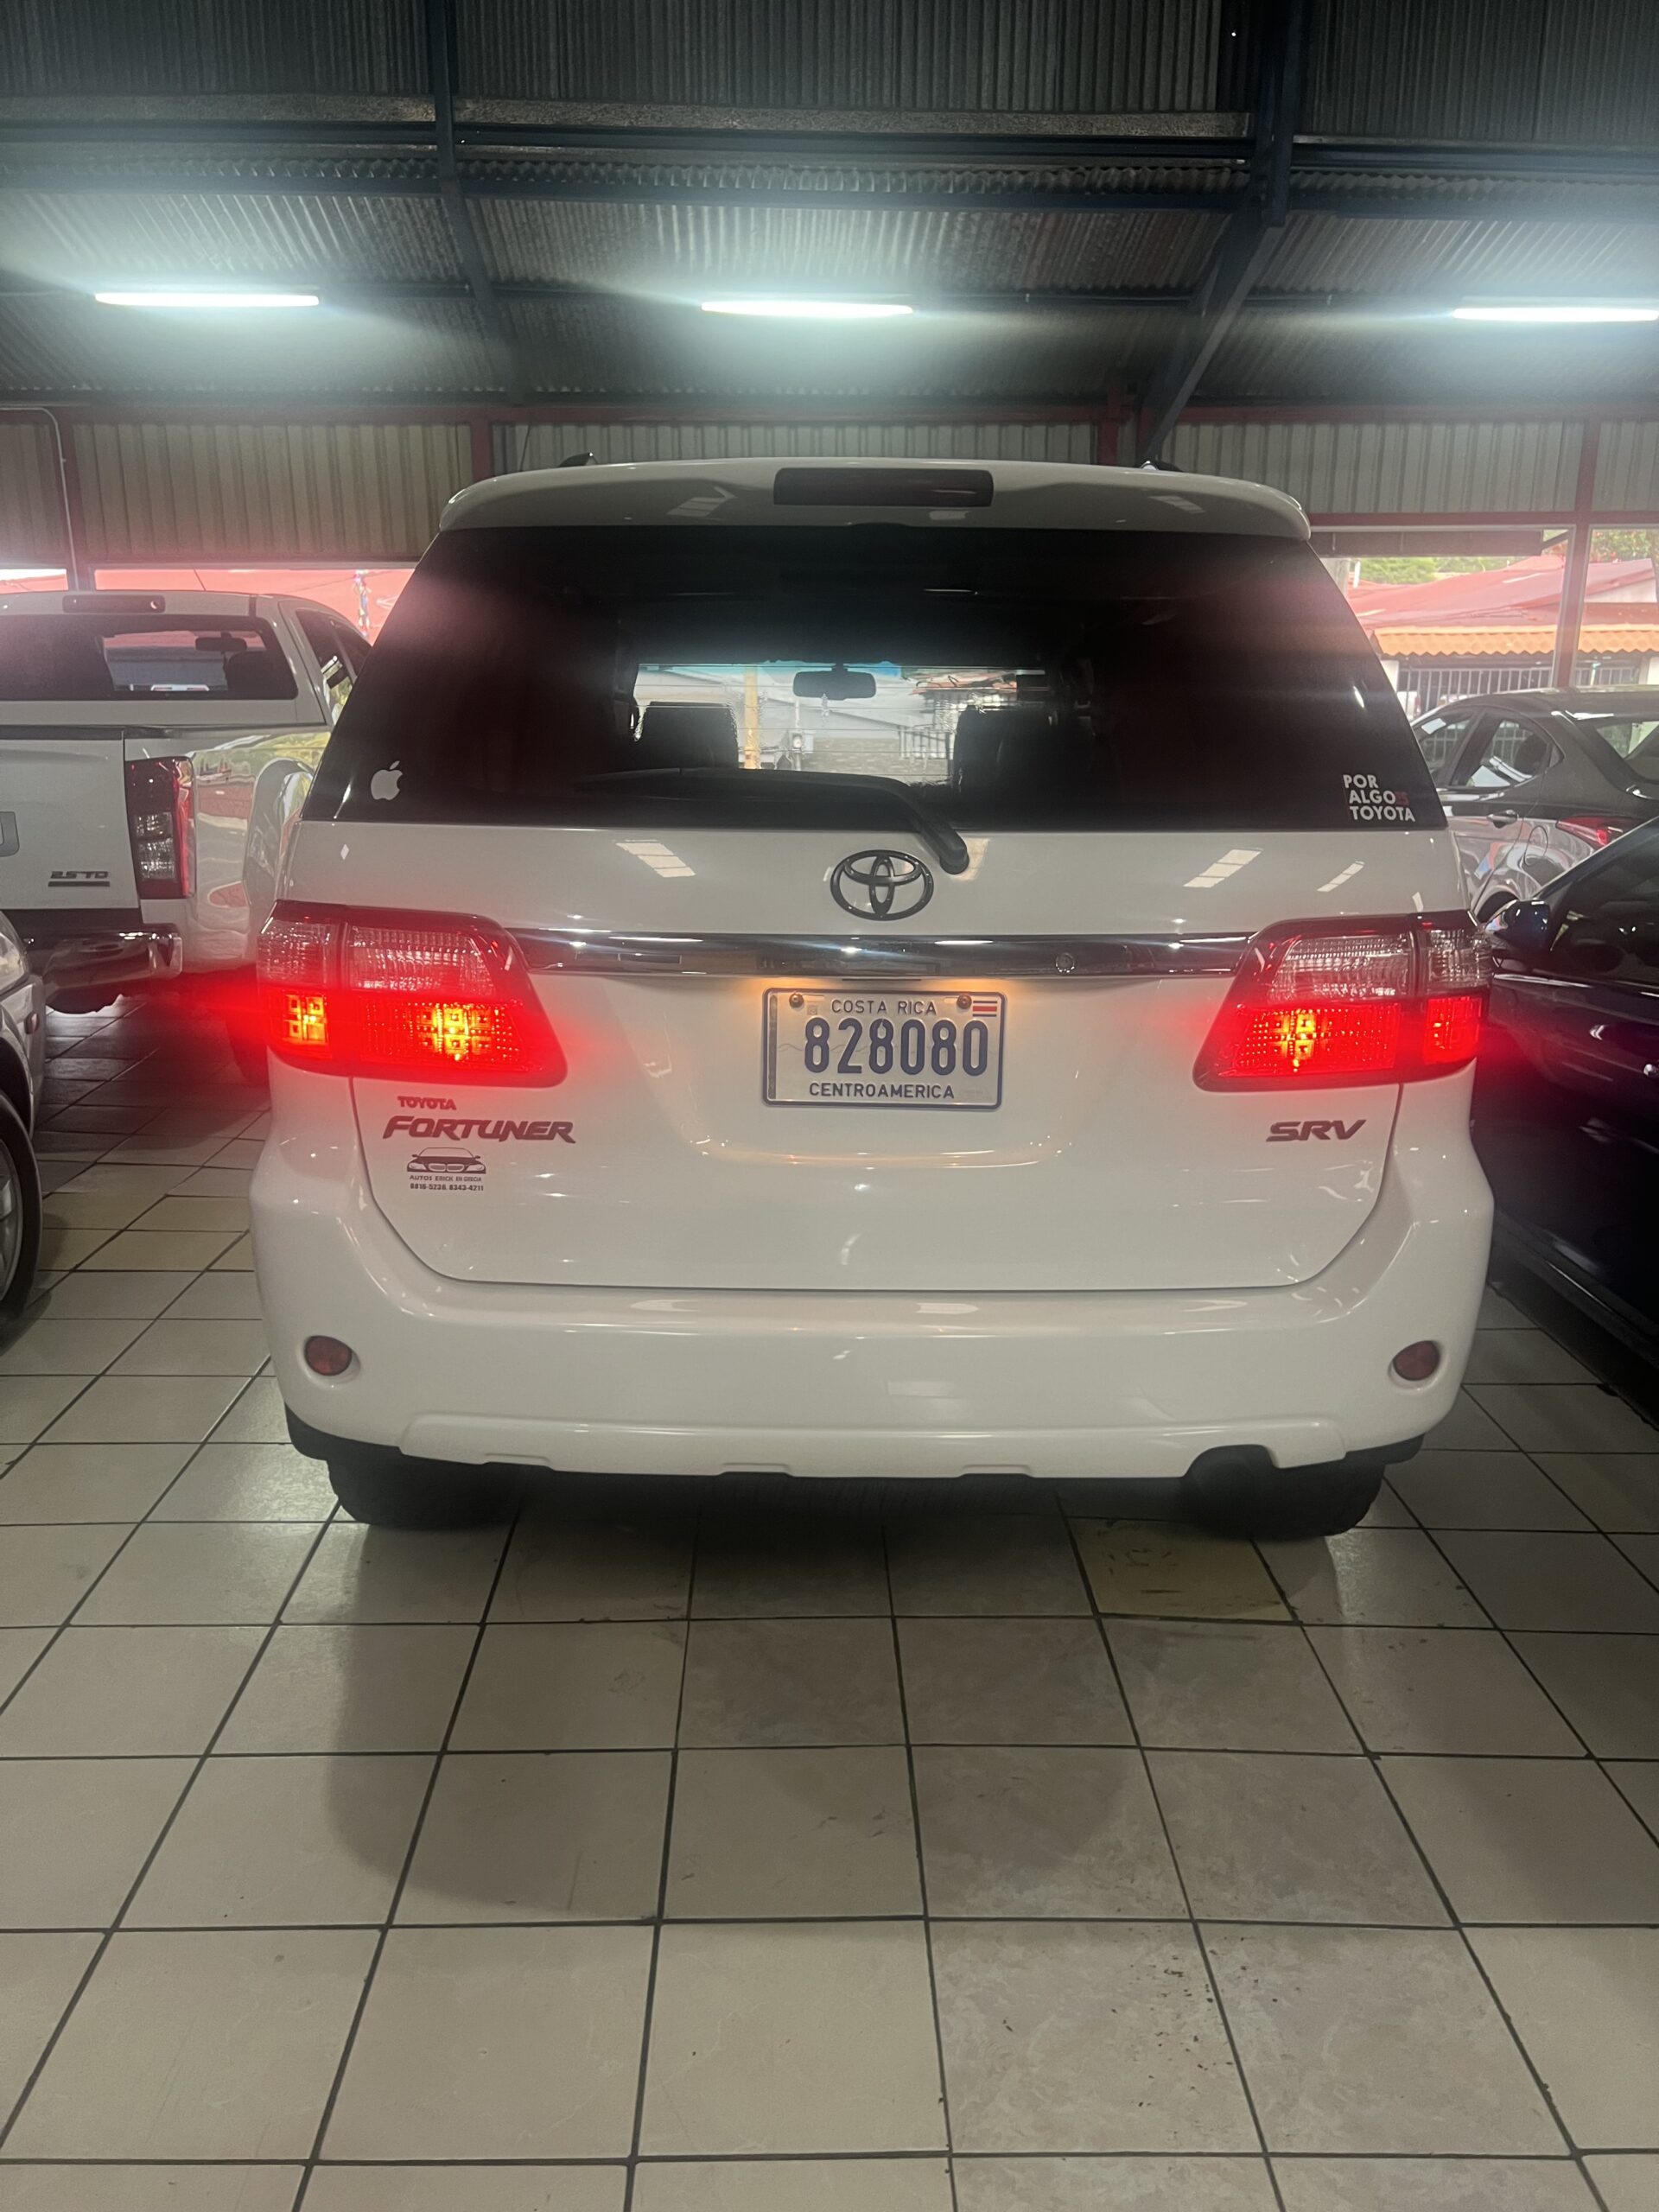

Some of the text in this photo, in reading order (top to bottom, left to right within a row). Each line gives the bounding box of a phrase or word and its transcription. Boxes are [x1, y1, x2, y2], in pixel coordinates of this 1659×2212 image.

[1343, 774, 1379, 788] POR
[1349, 790, 1396, 804] ALGO
[1350, 805, 1416, 822] TOYOTA
[831, 999, 937, 1015] COSTA RICA
[804, 1017, 988, 1076] 828080
[809, 1083, 955, 1099] CENTROAMERICA
[397, 1096, 457, 1110] TOYOTA
[383, 1116, 576, 1144] FORTUNER
[1266, 1119, 1367, 1142] SRV
